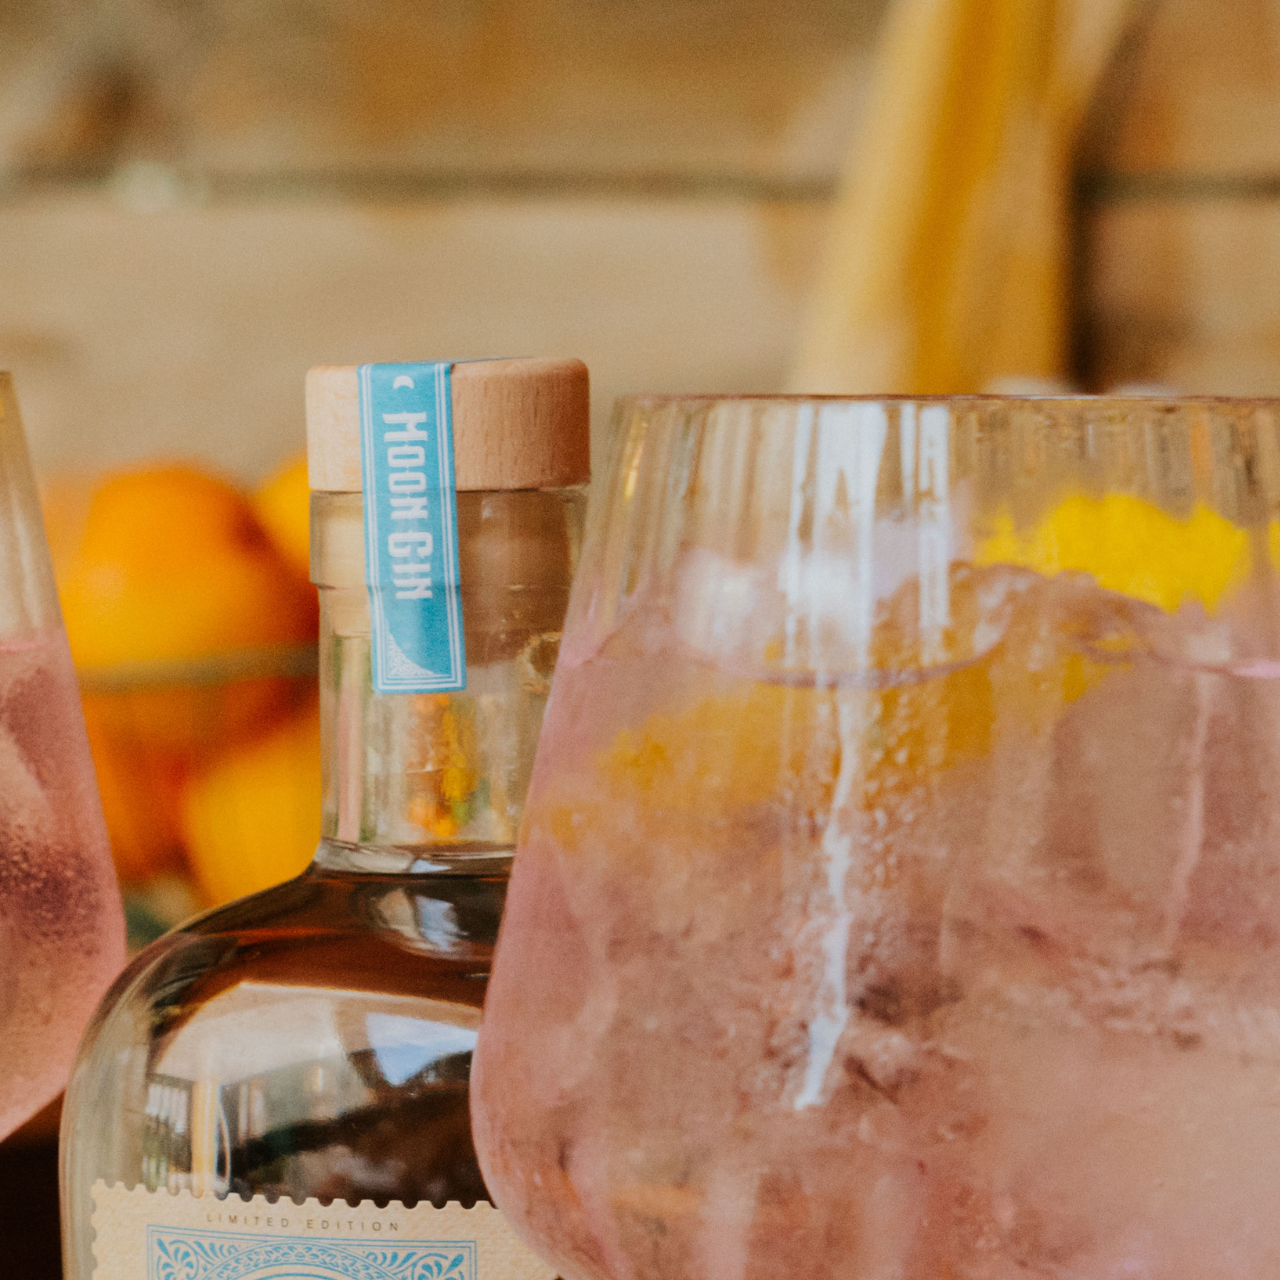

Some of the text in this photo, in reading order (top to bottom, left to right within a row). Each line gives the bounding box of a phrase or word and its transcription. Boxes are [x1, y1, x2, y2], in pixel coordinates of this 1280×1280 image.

[382, 411, 433, 600] MOON GIN
[207, 1214, 399, 1231] LIMITED EDITION
